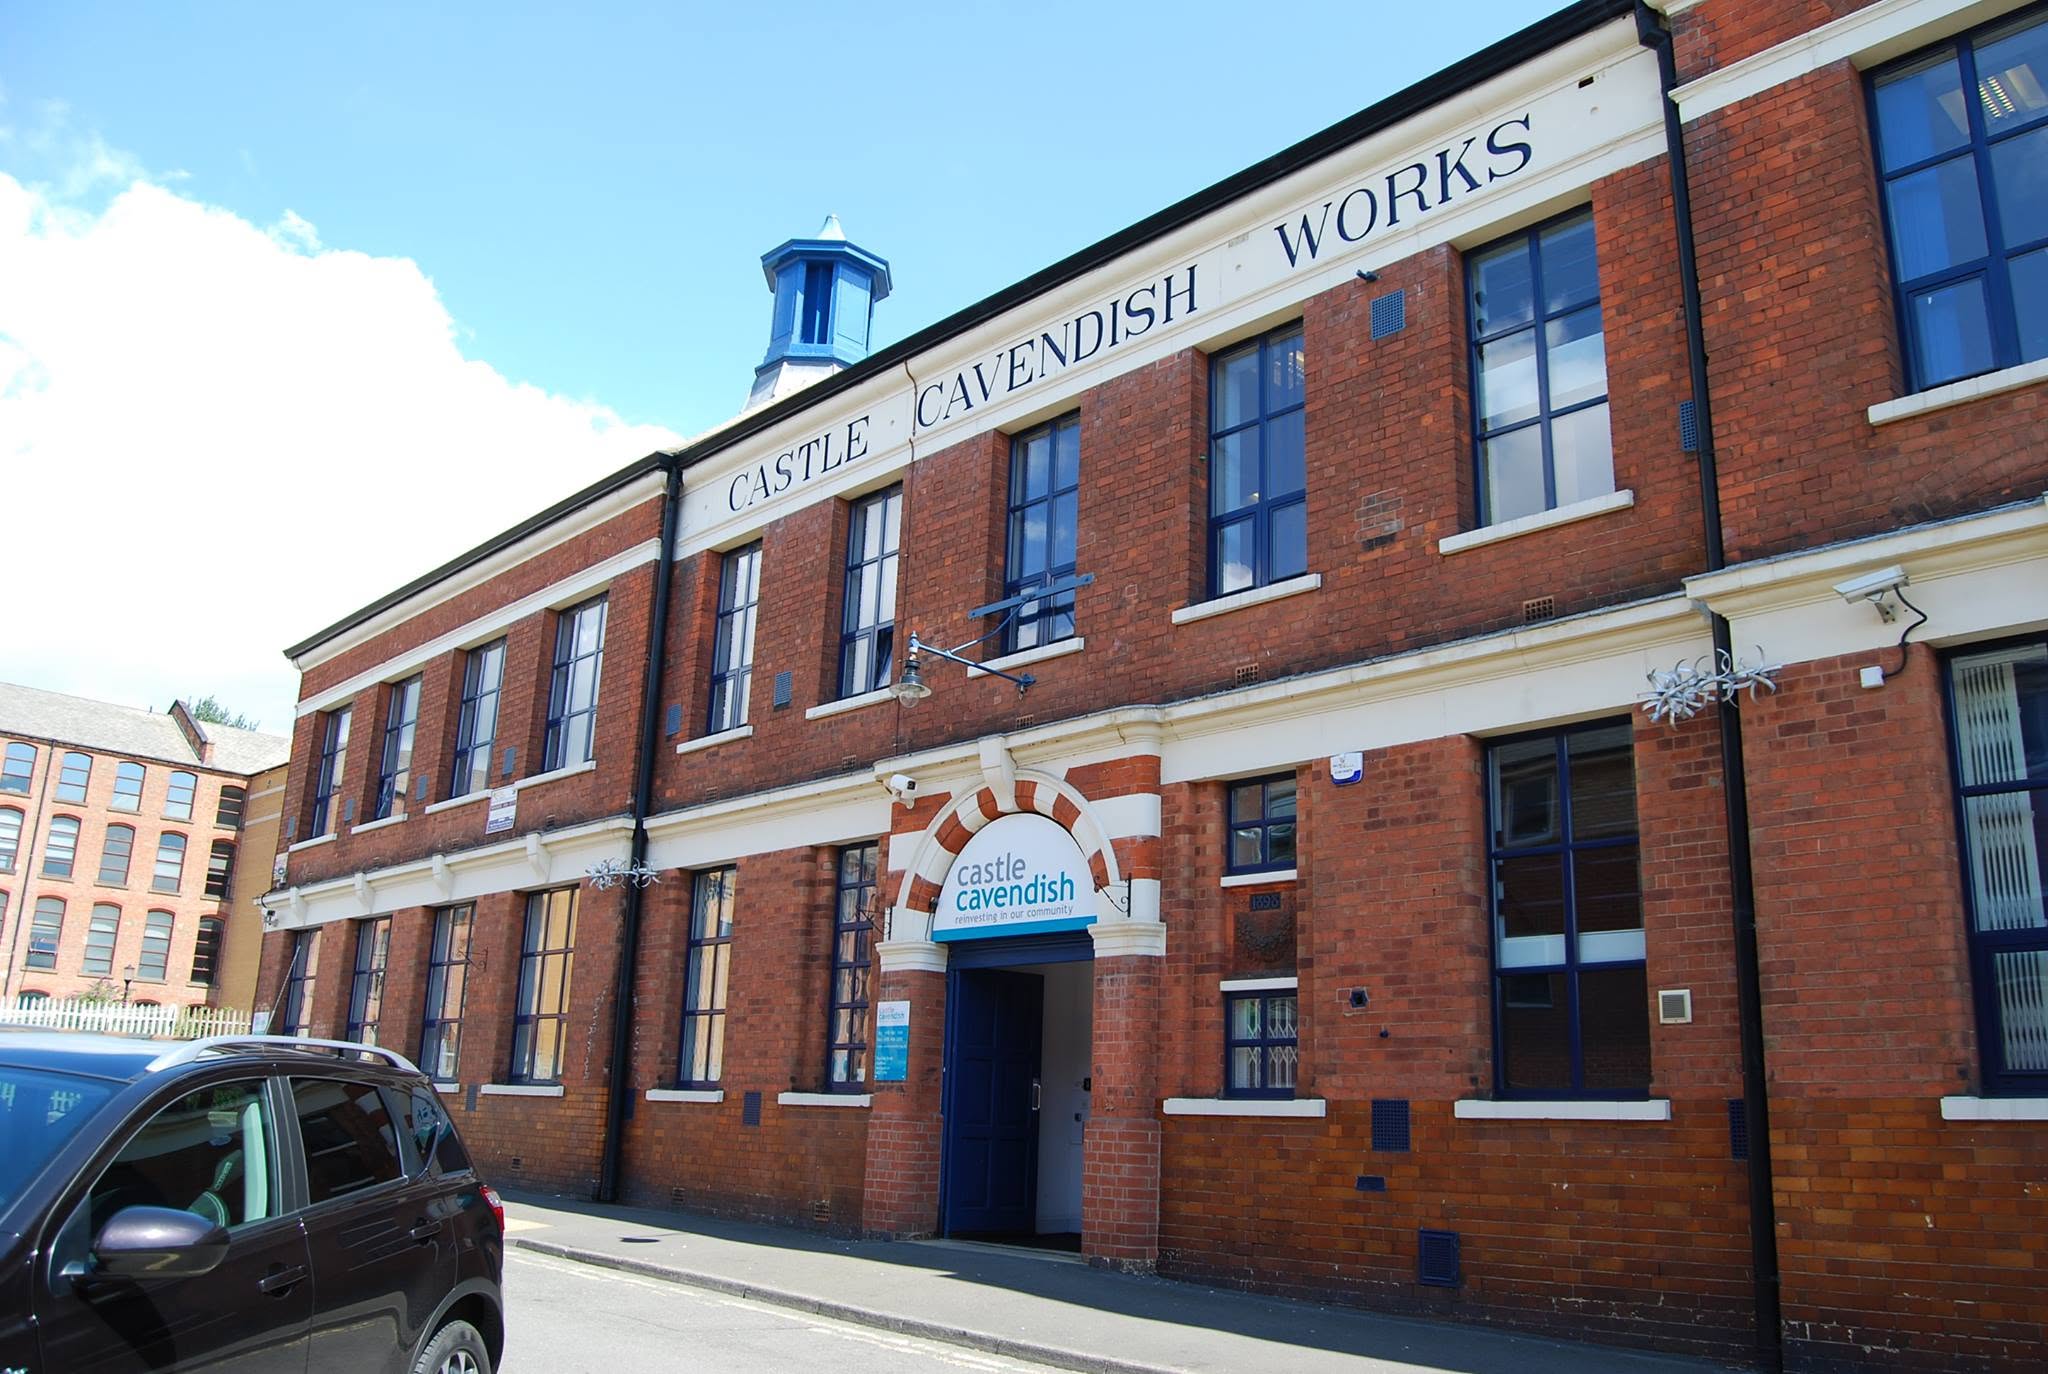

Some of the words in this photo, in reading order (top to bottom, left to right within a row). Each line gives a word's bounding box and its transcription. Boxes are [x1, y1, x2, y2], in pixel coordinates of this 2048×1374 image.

[728, 414, 871, 513] CASTLE
[914, 265, 1198, 429] CAVENDISH
[1274, 112, 1533, 269] WORKS
[957, 852, 1026, 887] castle
[956, 871, 1074, 912] cavendish
[954, 913, 998, 925] reinvesting
[1000, 911, 1008, 920] in
[1010, 910, 1025, 919] our
[1027, 905, 1074, 918] community
